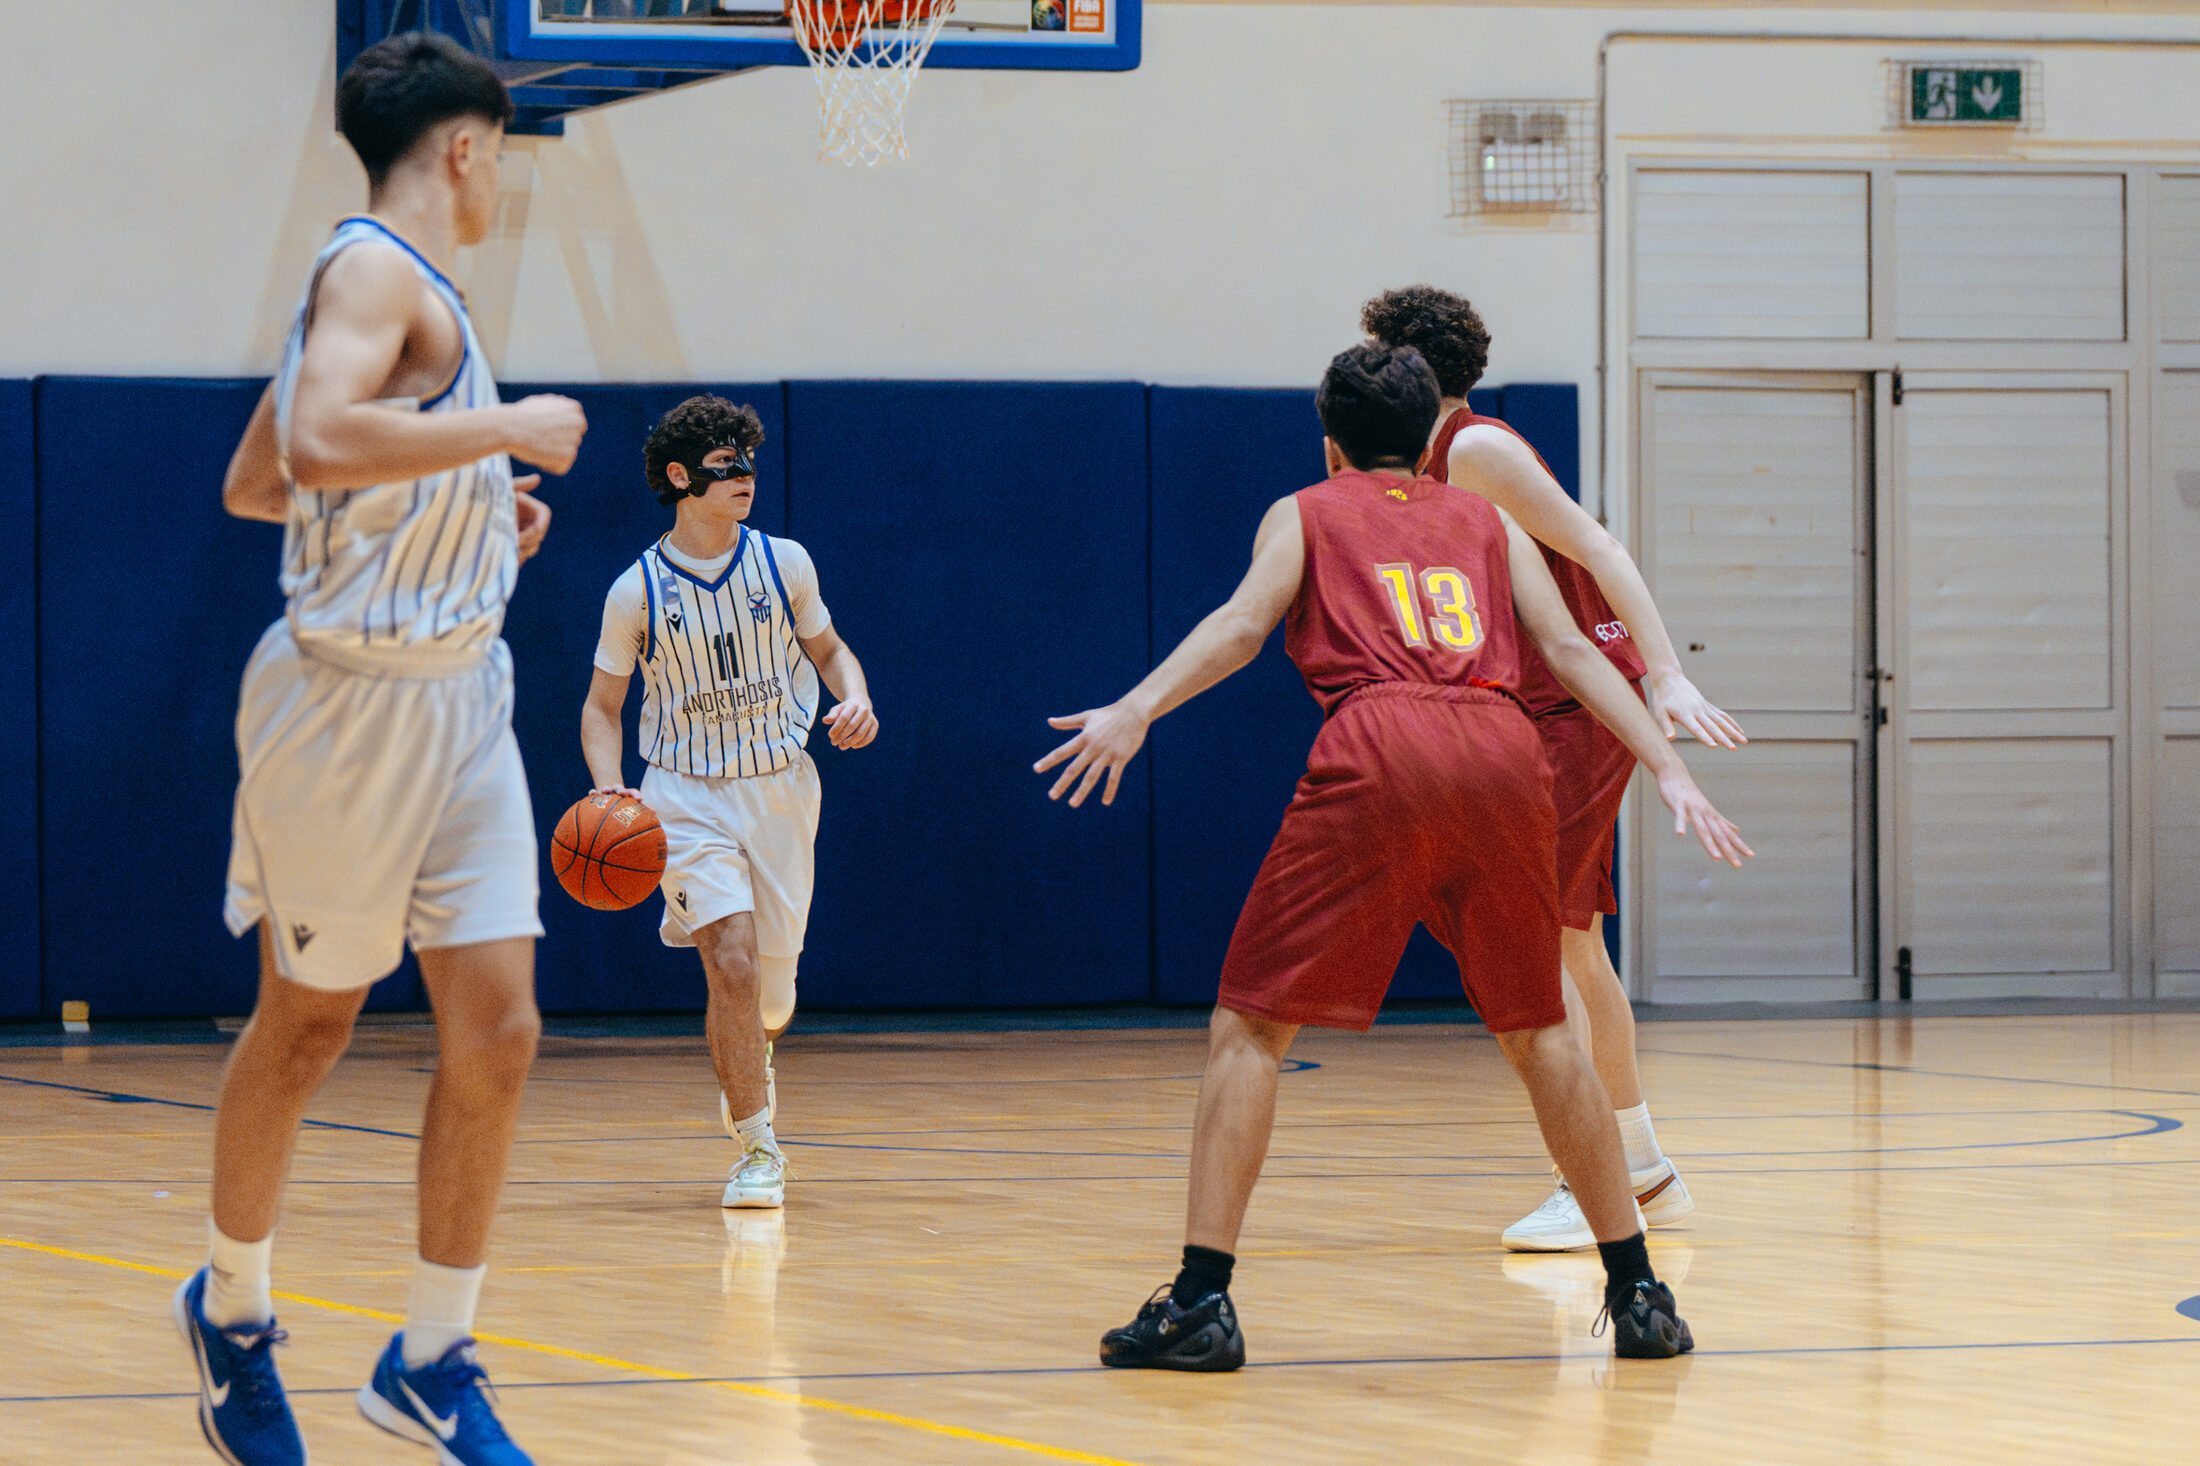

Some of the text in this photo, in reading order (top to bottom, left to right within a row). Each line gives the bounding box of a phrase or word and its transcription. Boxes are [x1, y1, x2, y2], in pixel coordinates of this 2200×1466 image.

[1374, 562, 1485, 653] 13
[712, 631, 740, 681] 11
[682, 676, 784, 714] ANORTHOSIS
